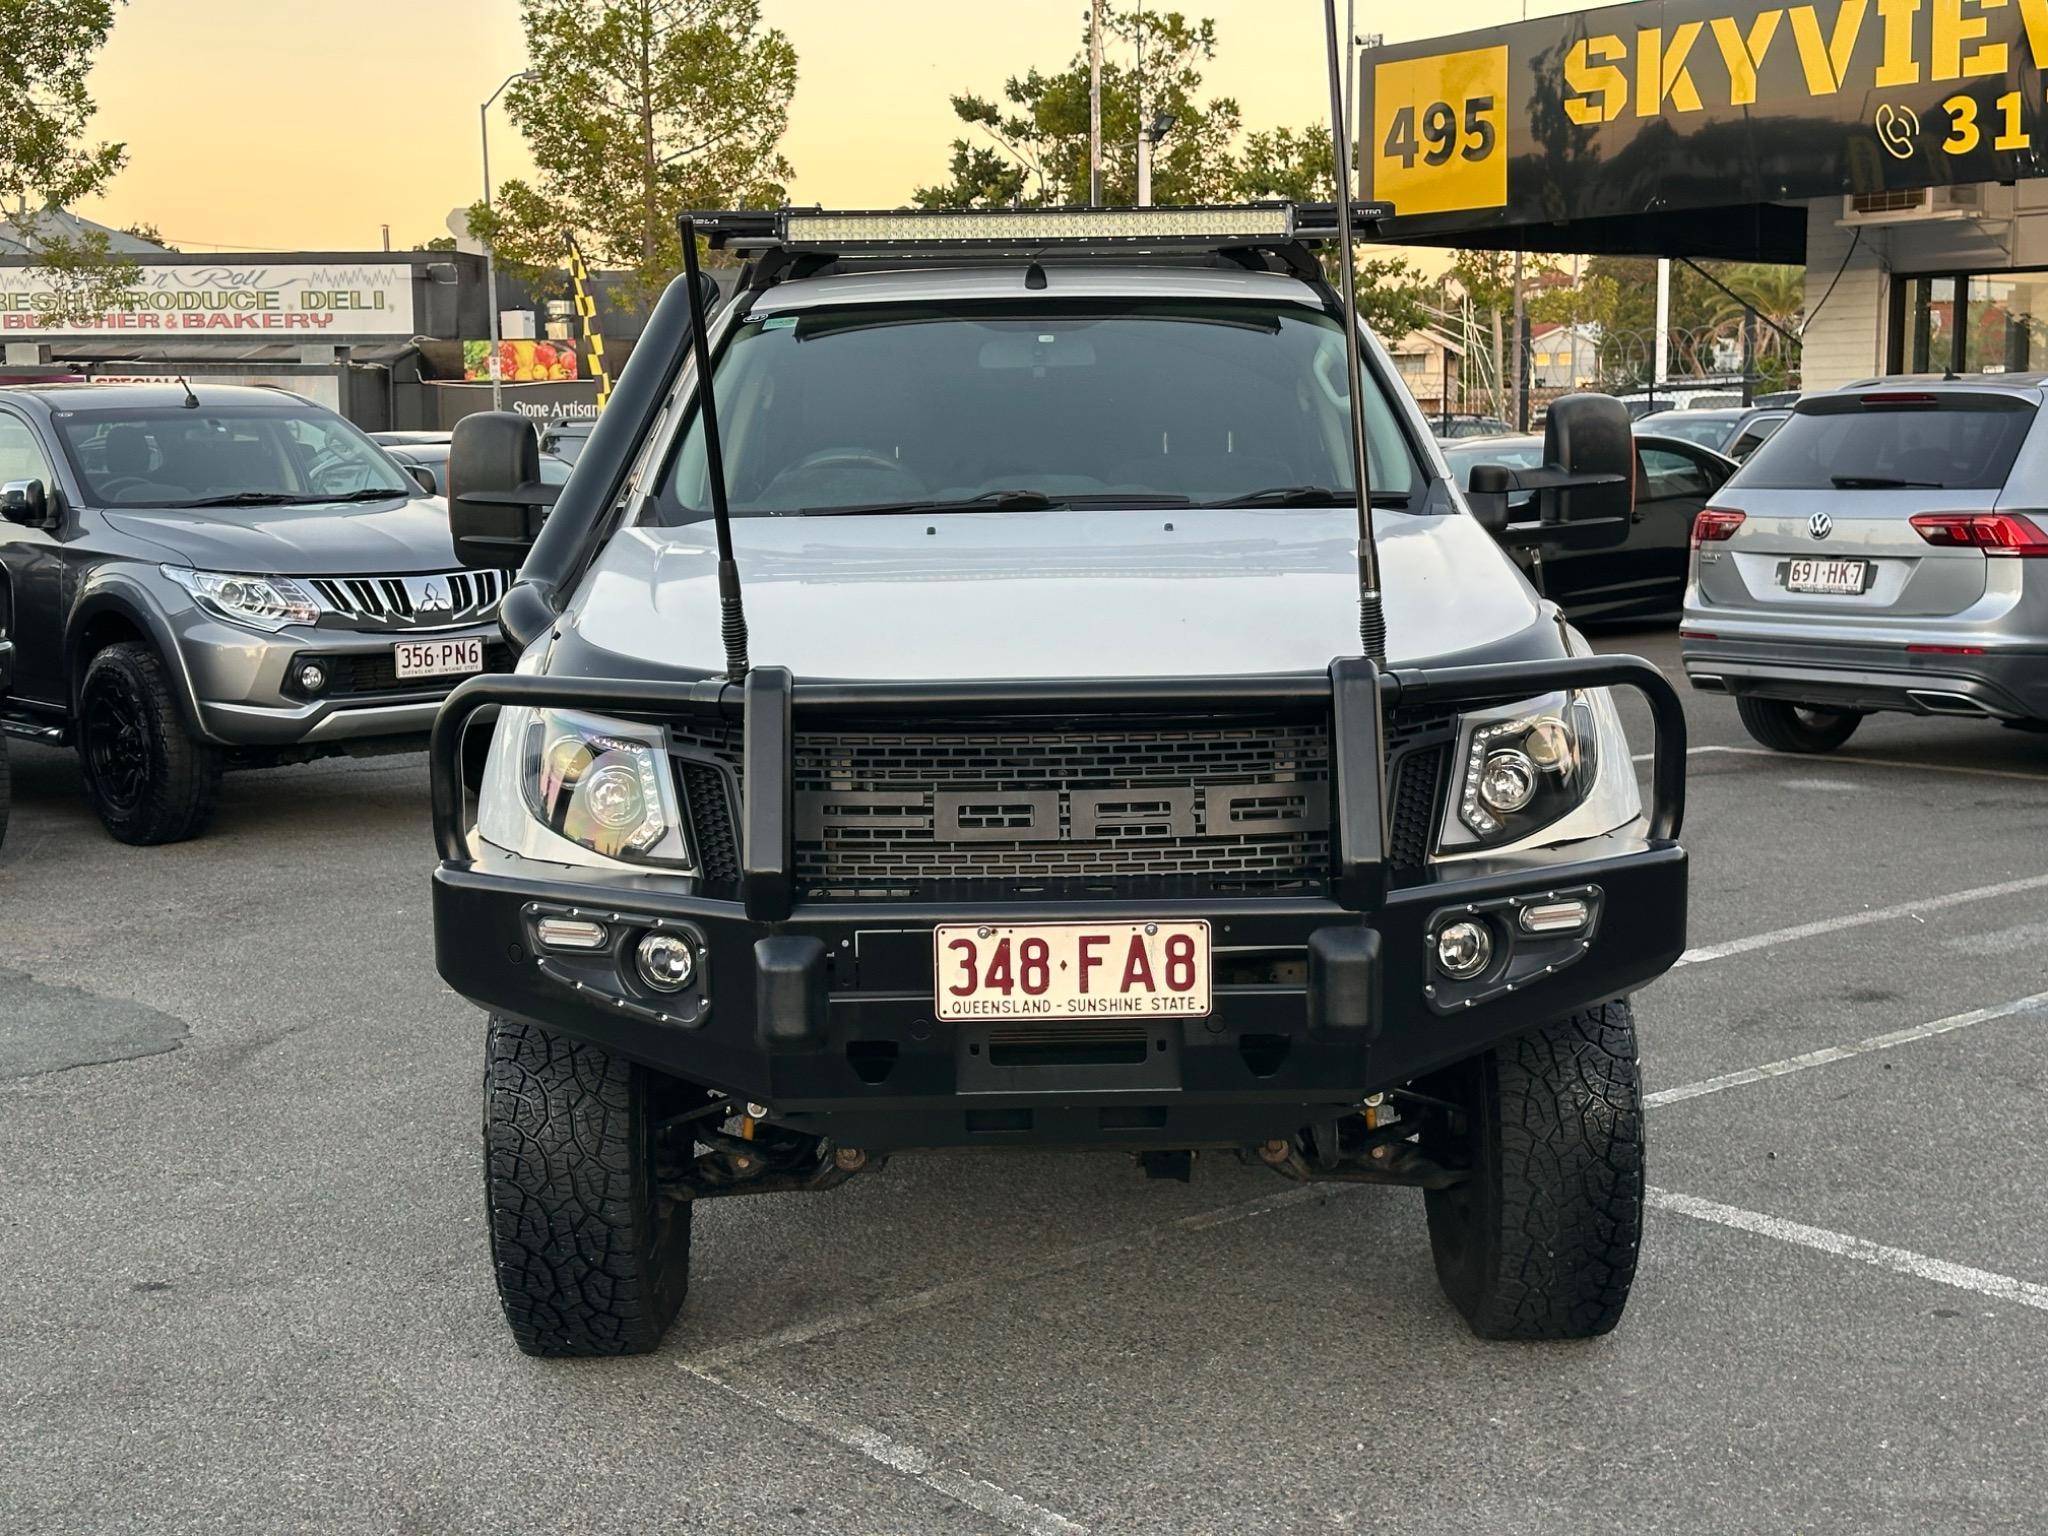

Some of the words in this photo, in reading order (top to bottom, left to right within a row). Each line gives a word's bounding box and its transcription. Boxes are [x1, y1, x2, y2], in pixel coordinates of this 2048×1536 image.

[1383, 95, 1495, 170] 495
[164, 314, 178, 329] &
[182, 313, 334, 329] BAKERY
[513, 400, 549, 418] Stone
[952, 1000, 1051, 1014] QUEENSLAND
[1068, 998, 1142, 1012] SUNSHINE
[1151, 997, 1196, 1010] STATE
